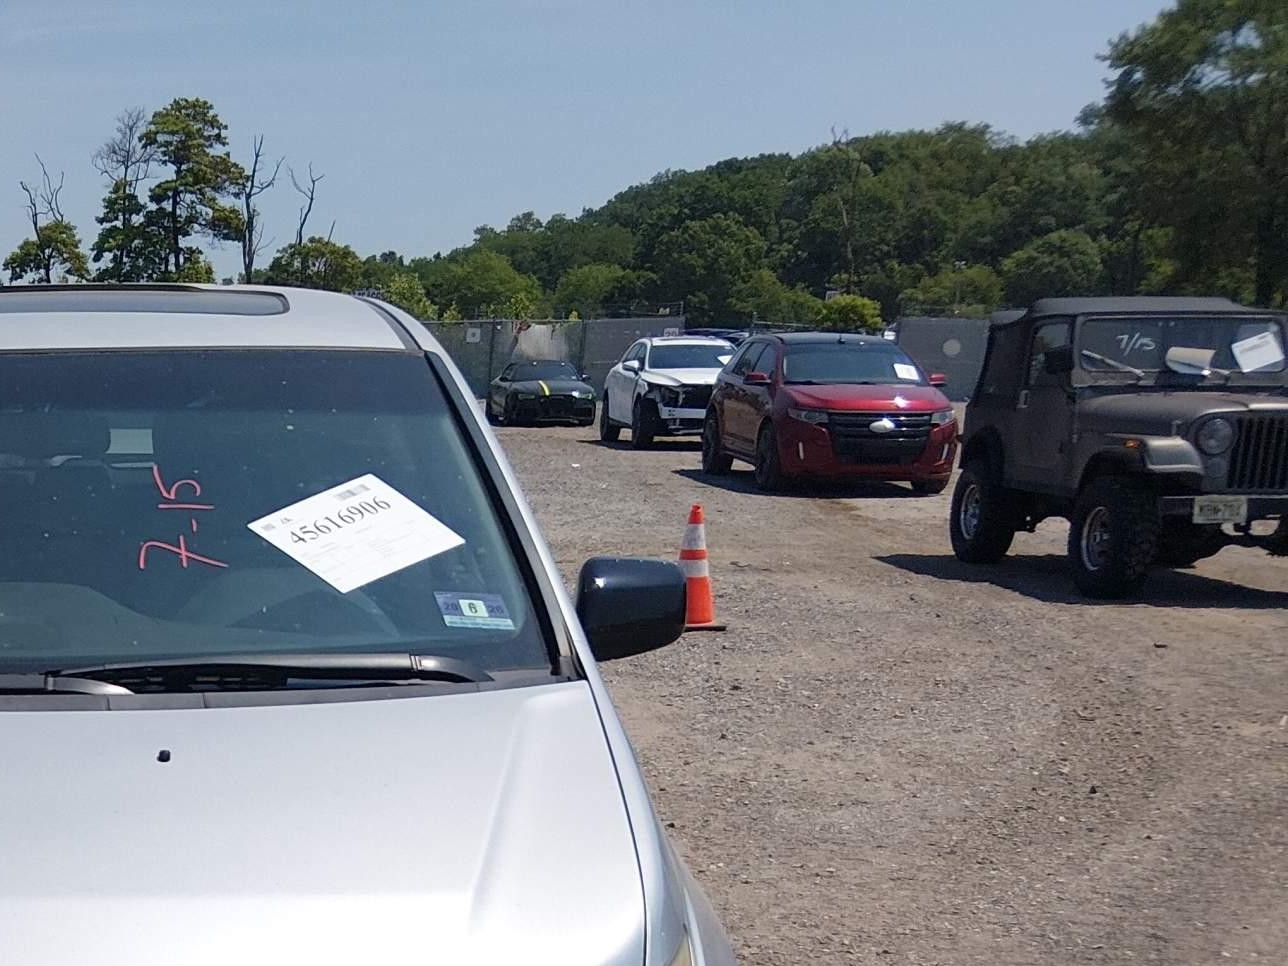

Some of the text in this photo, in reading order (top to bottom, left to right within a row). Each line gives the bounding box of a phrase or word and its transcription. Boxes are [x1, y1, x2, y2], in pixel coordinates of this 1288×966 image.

[139, 464, 230, 569] 7-15
[289, 496, 392, 545] 45616906
[467, 602, 478, 614] 6
